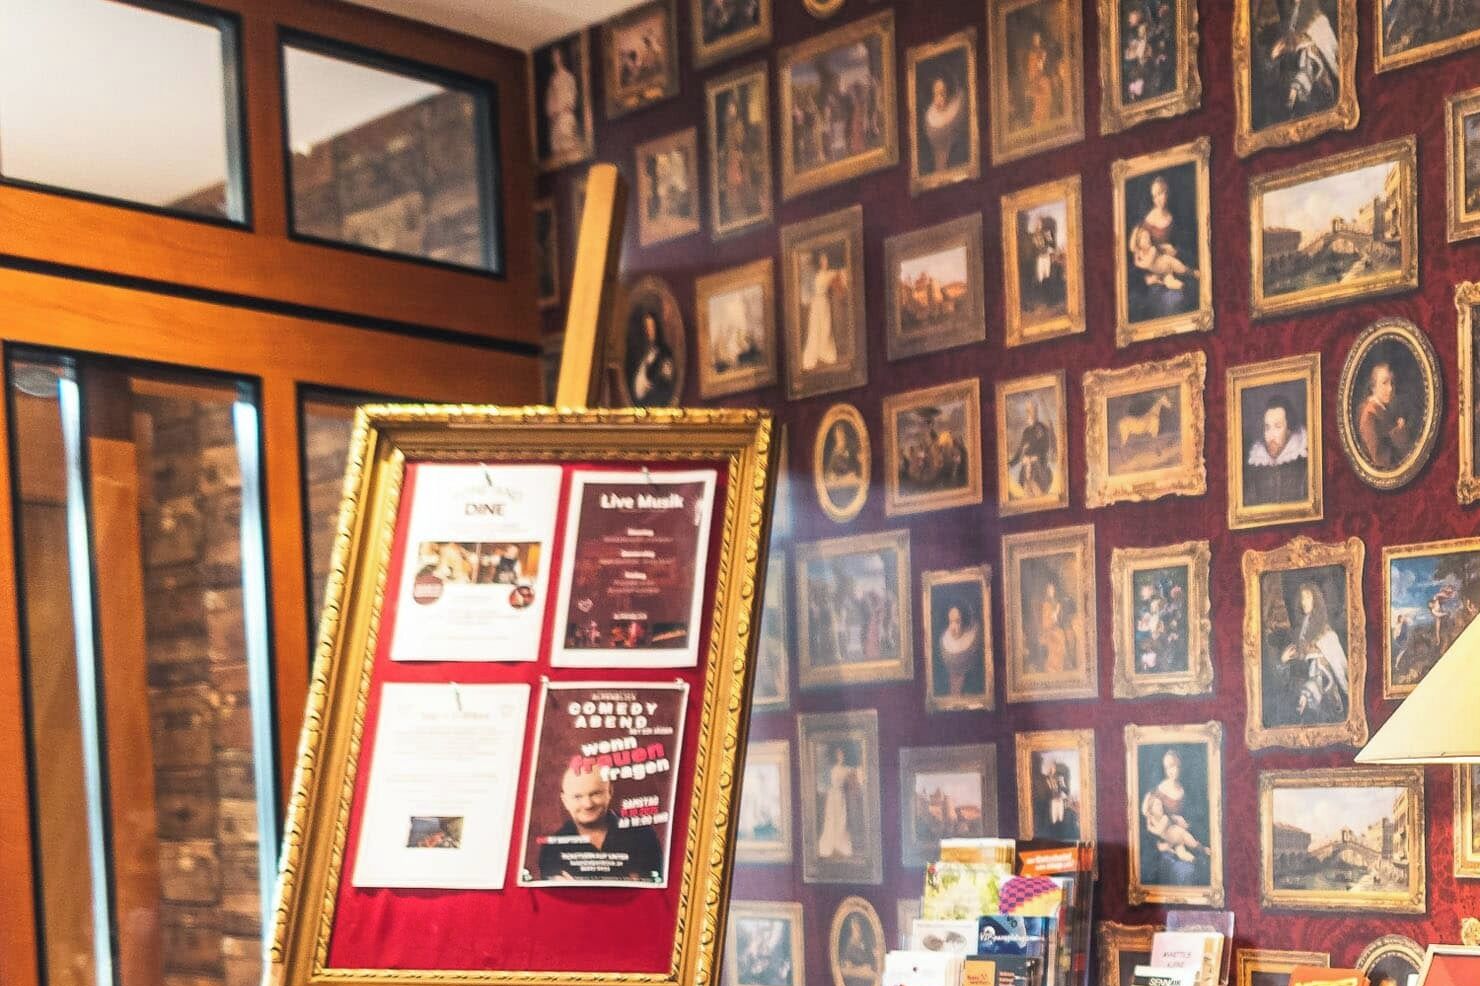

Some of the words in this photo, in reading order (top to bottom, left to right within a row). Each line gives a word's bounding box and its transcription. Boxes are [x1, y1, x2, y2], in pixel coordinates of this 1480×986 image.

[600, 493, 634, 509] Live
[637, 493, 684, 509] Musik
[568, 701, 658, 716] COMEDY
[575, 715, 648, 729] ABEND
[581, 736, 638, 757] wenn
[569, 742, 665, 777] frauen
[600, 758, 670, 782] fragen
